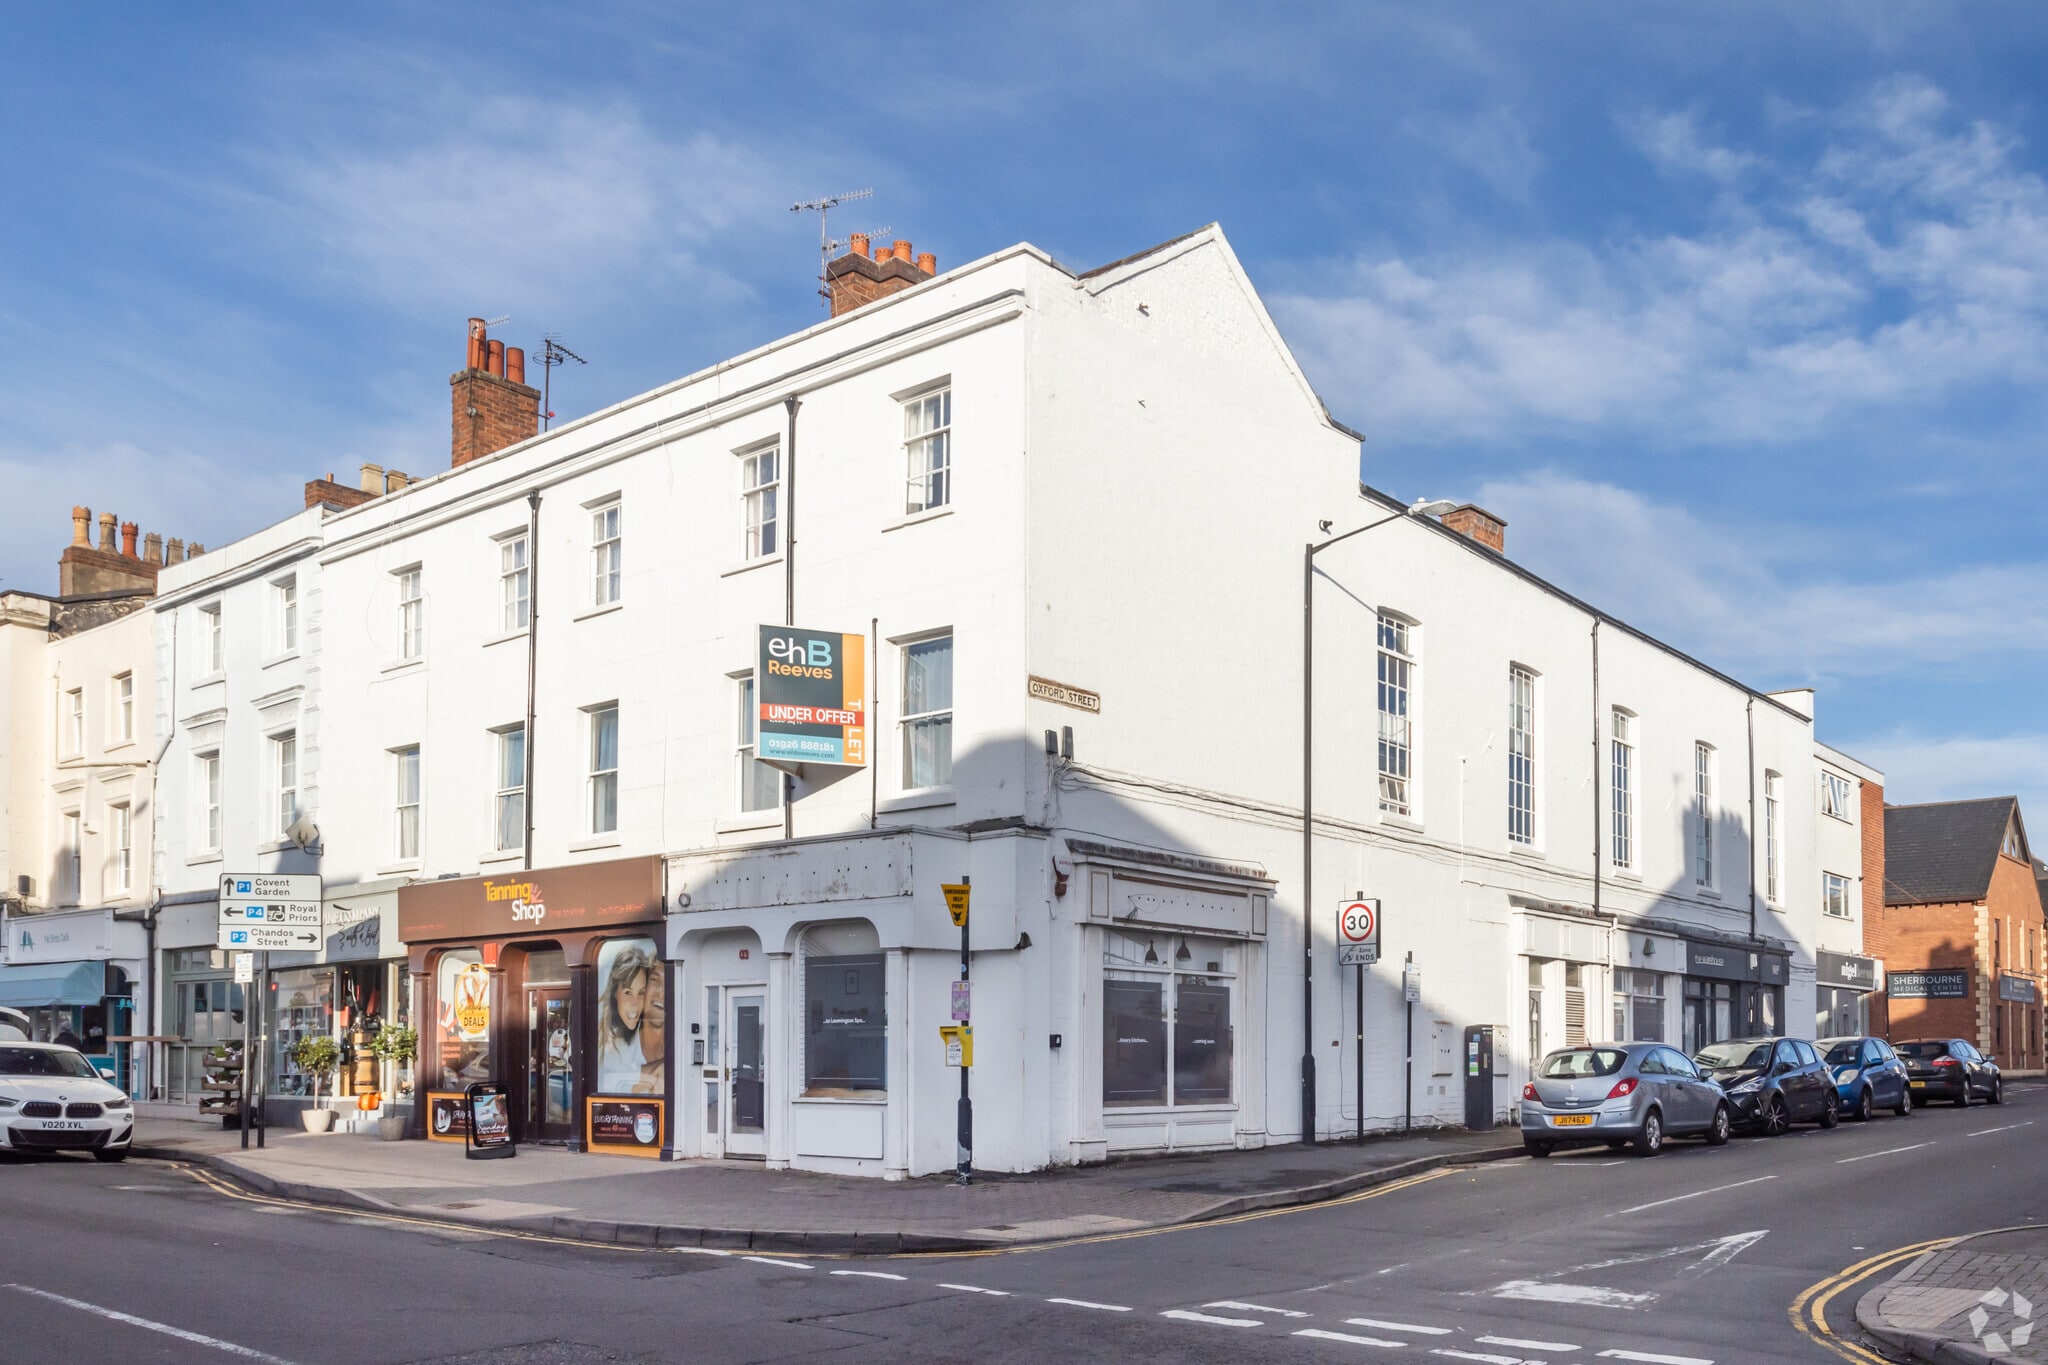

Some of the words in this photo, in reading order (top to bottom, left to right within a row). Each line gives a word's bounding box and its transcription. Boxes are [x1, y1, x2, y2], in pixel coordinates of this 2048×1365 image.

[768, 637, 833, 667] ehB
[768, 659, 833, 680] Reeves
[1032, 683, 1065, 700] OXFORD
[1068, 692, 1097, 708] STREET
[769, 706, 812, 721] UNDER
[816, 709, 856, 725] OFFER
[769, 739, 798, 750] 01926
[848, 728, 862, 760] LET
[769, 749, 835, 759] www.ehbreeves.com
[238, 883, 250, 891] P1
[255, 878, 290, 886] Covent
[254, 888, 290, 896] Garden
[483, 879, 531, 904] Tanning
[248, 908, 263, 916] P4
[289, 904, 317, 914] Royal
[511, 898, 546, 925] Shop
[289, 913, 318, 922] Priors
[1346, 914, 1369, 930] 30
[232, 933, 247, 941] P2
[251, 928, 294, 937] Chandos
[256, 938, 288, 946] Street
[1841, 961, 1857, 980] nigel
[1893, 975, 1963, 985] SHERBOURNE
[463, 1016, 485, 1026] DEALS
[67, 1121, 84, 1129] XVL
